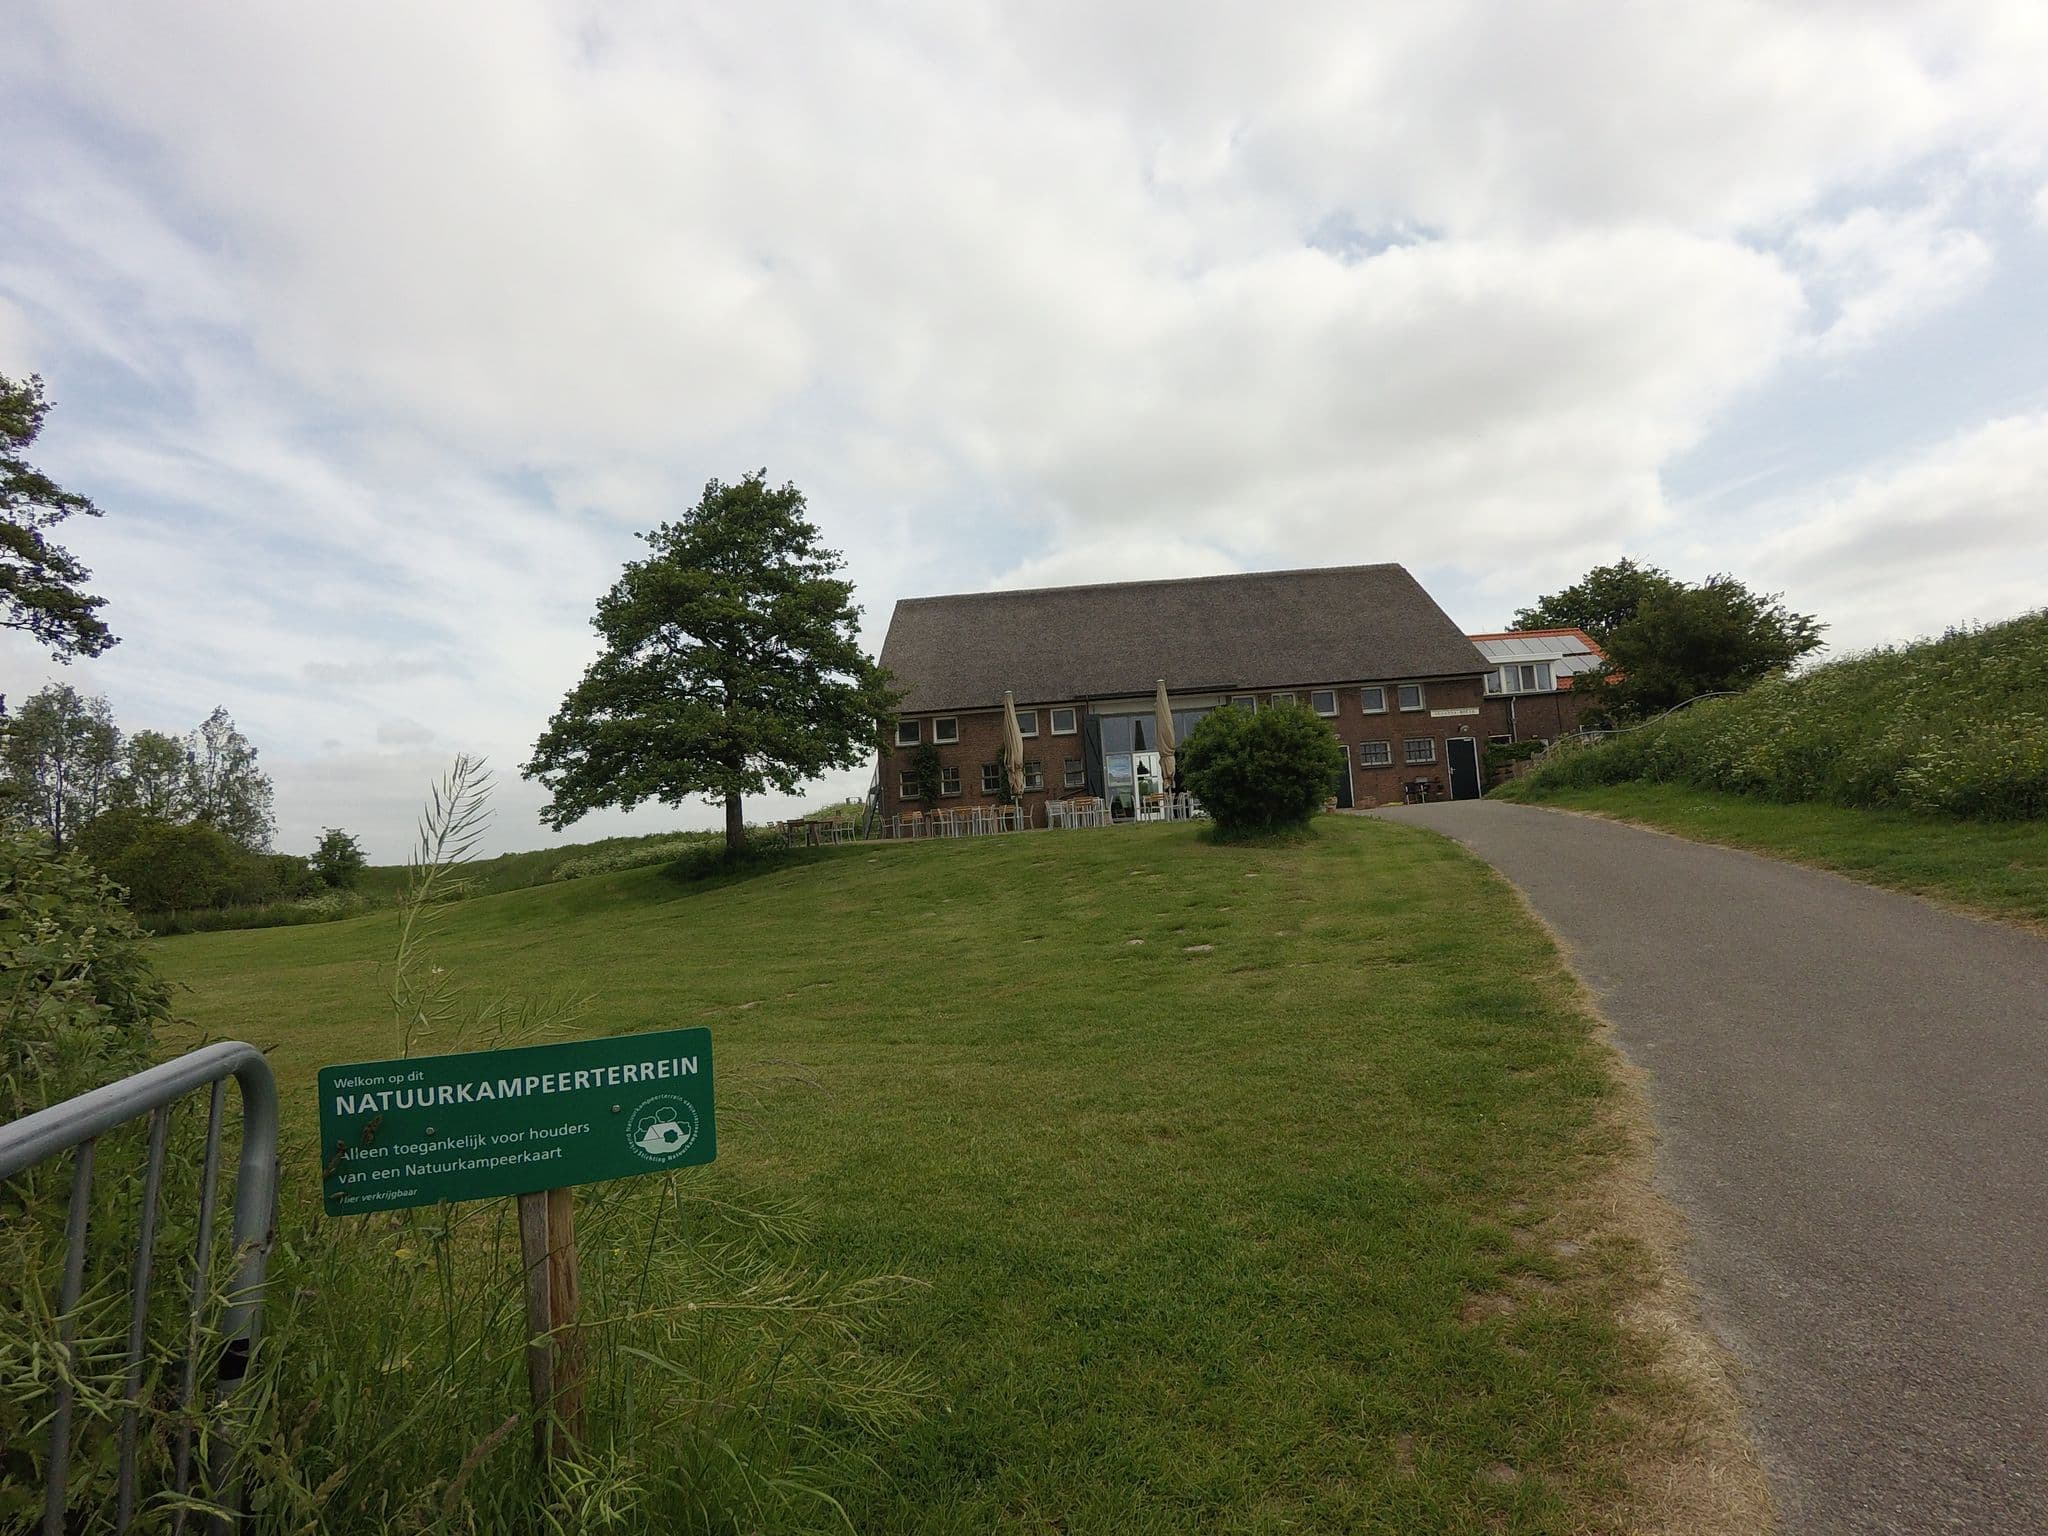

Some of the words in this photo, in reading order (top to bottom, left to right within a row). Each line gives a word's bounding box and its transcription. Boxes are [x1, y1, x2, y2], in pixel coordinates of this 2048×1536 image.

[333, 1075, 385, 1089] Welkom
[388, 1074, 405, 1085] op
[407, 1071, 425, 1082] dit
[335, 1055, 699, 1116] NATUURKAMPEERTERREIN
[392, 1132, 486, 1156] toegankelijk
[490, 1131, 525, 1144] voor
[529, 1122, 590, 1140] houders
[338, 1172, 367, 1184] van
[371, 1168, 400, 1180] een
[404, 1145, 562, 1177] Natuurkampeerkaart
[361, 1188, 418, 1202] verkrijgbaar
